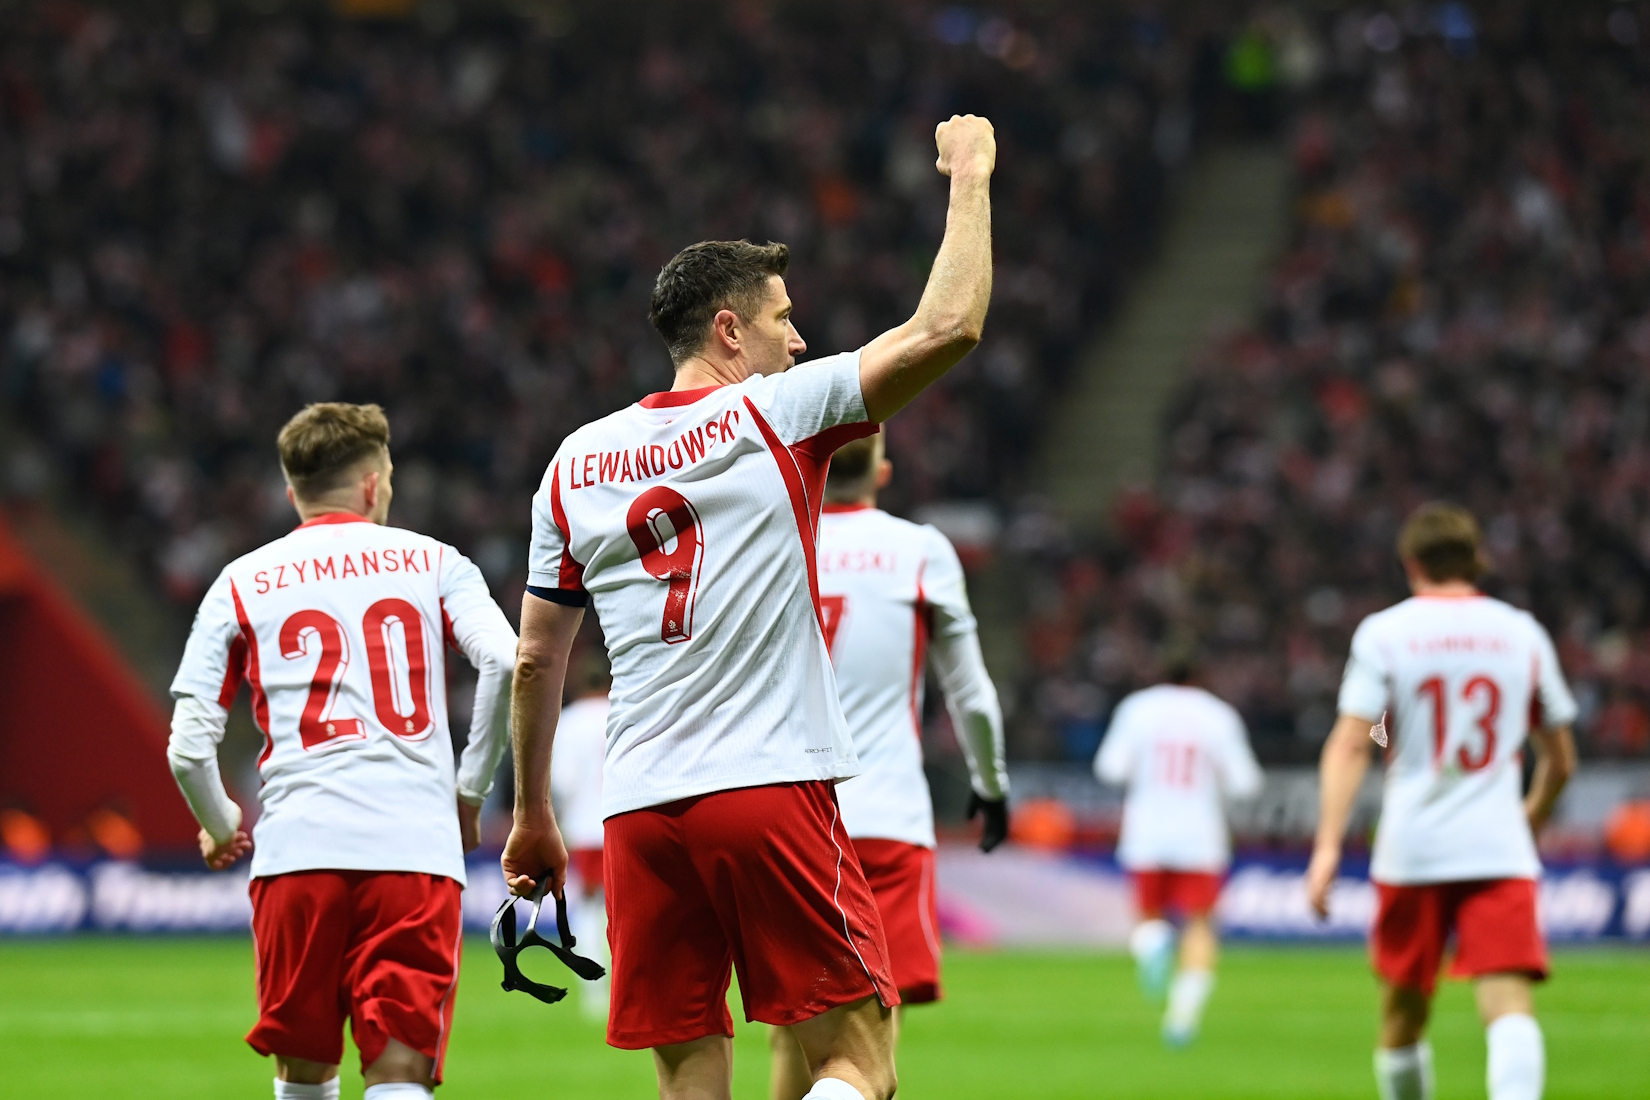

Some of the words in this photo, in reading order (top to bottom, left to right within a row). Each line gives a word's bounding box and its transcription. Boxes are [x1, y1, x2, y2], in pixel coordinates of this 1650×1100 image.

[254, 546, 431, 595] SZYMAŃSKI
[626, 485, 704, 645] 9
[279, 597, 436, 752] 20
[1415, 672, 1503, 775] 13
